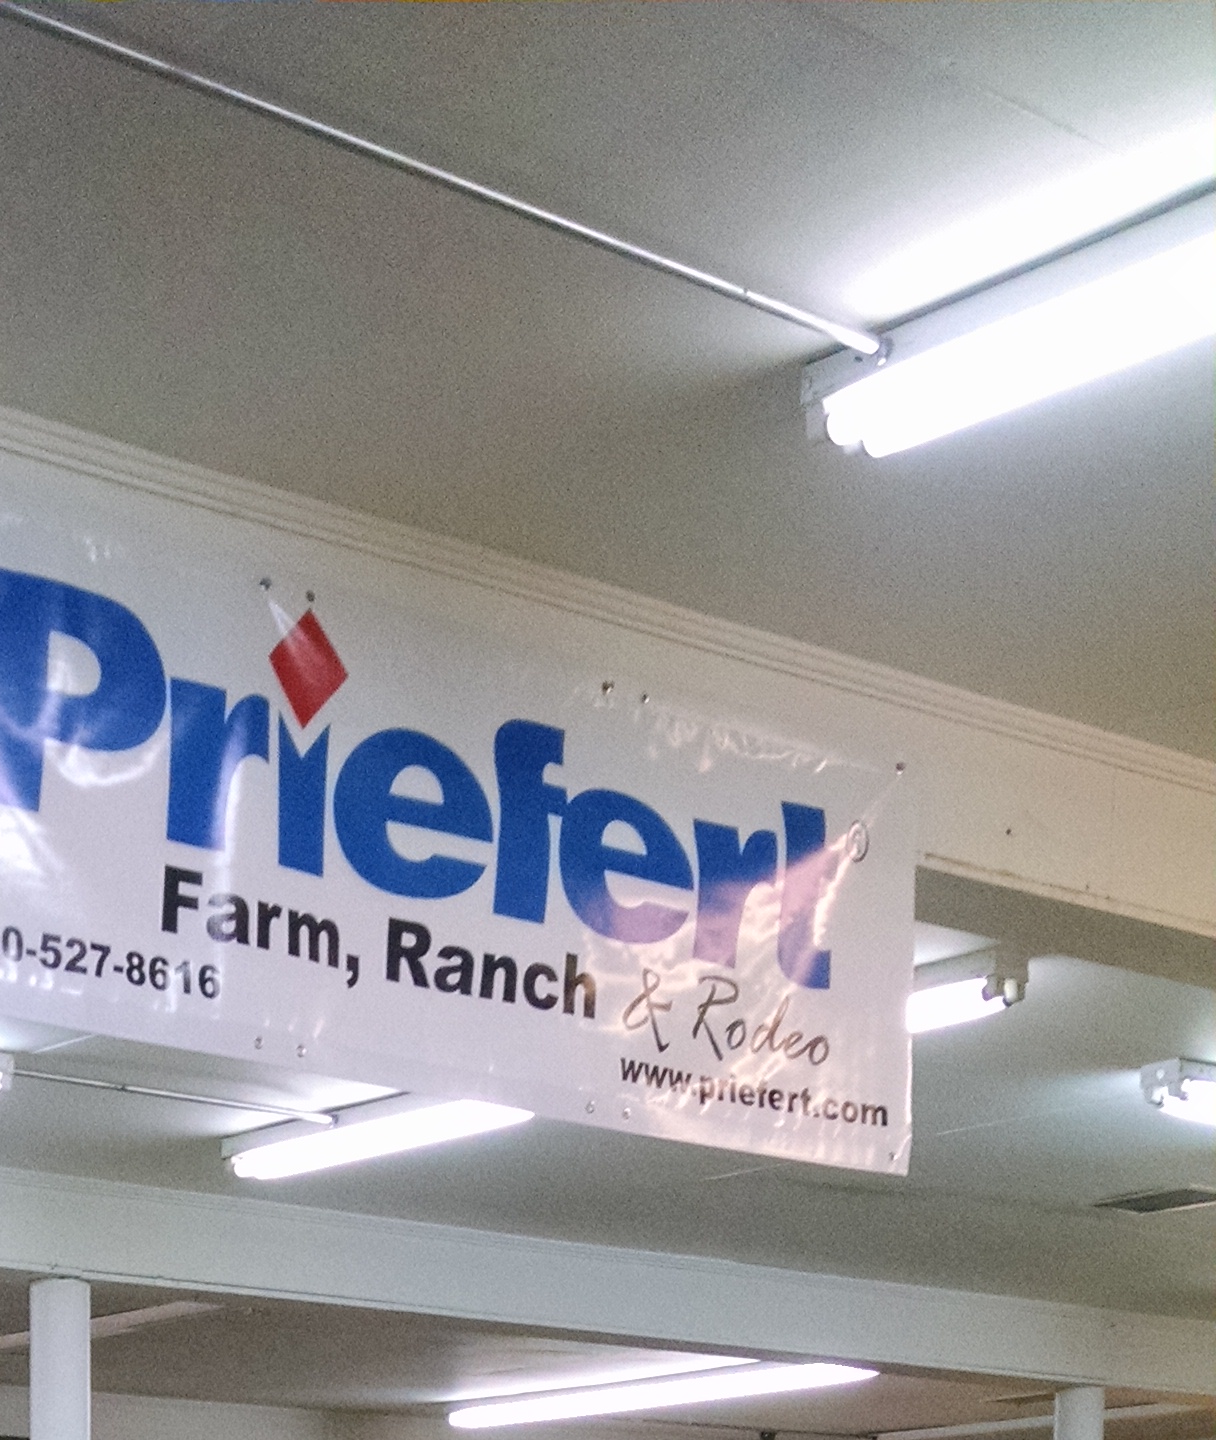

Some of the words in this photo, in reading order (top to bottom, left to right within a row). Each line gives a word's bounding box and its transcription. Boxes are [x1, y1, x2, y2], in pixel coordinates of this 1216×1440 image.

[161, 866, 360, 987] Farm,
[384, 917, 597, 1019] Ranch
[623, 970, 670, 1056] &
[692, 976, 832, 1069] Rodeo
[620, 1054, 888, 1128] www.priefert.com
